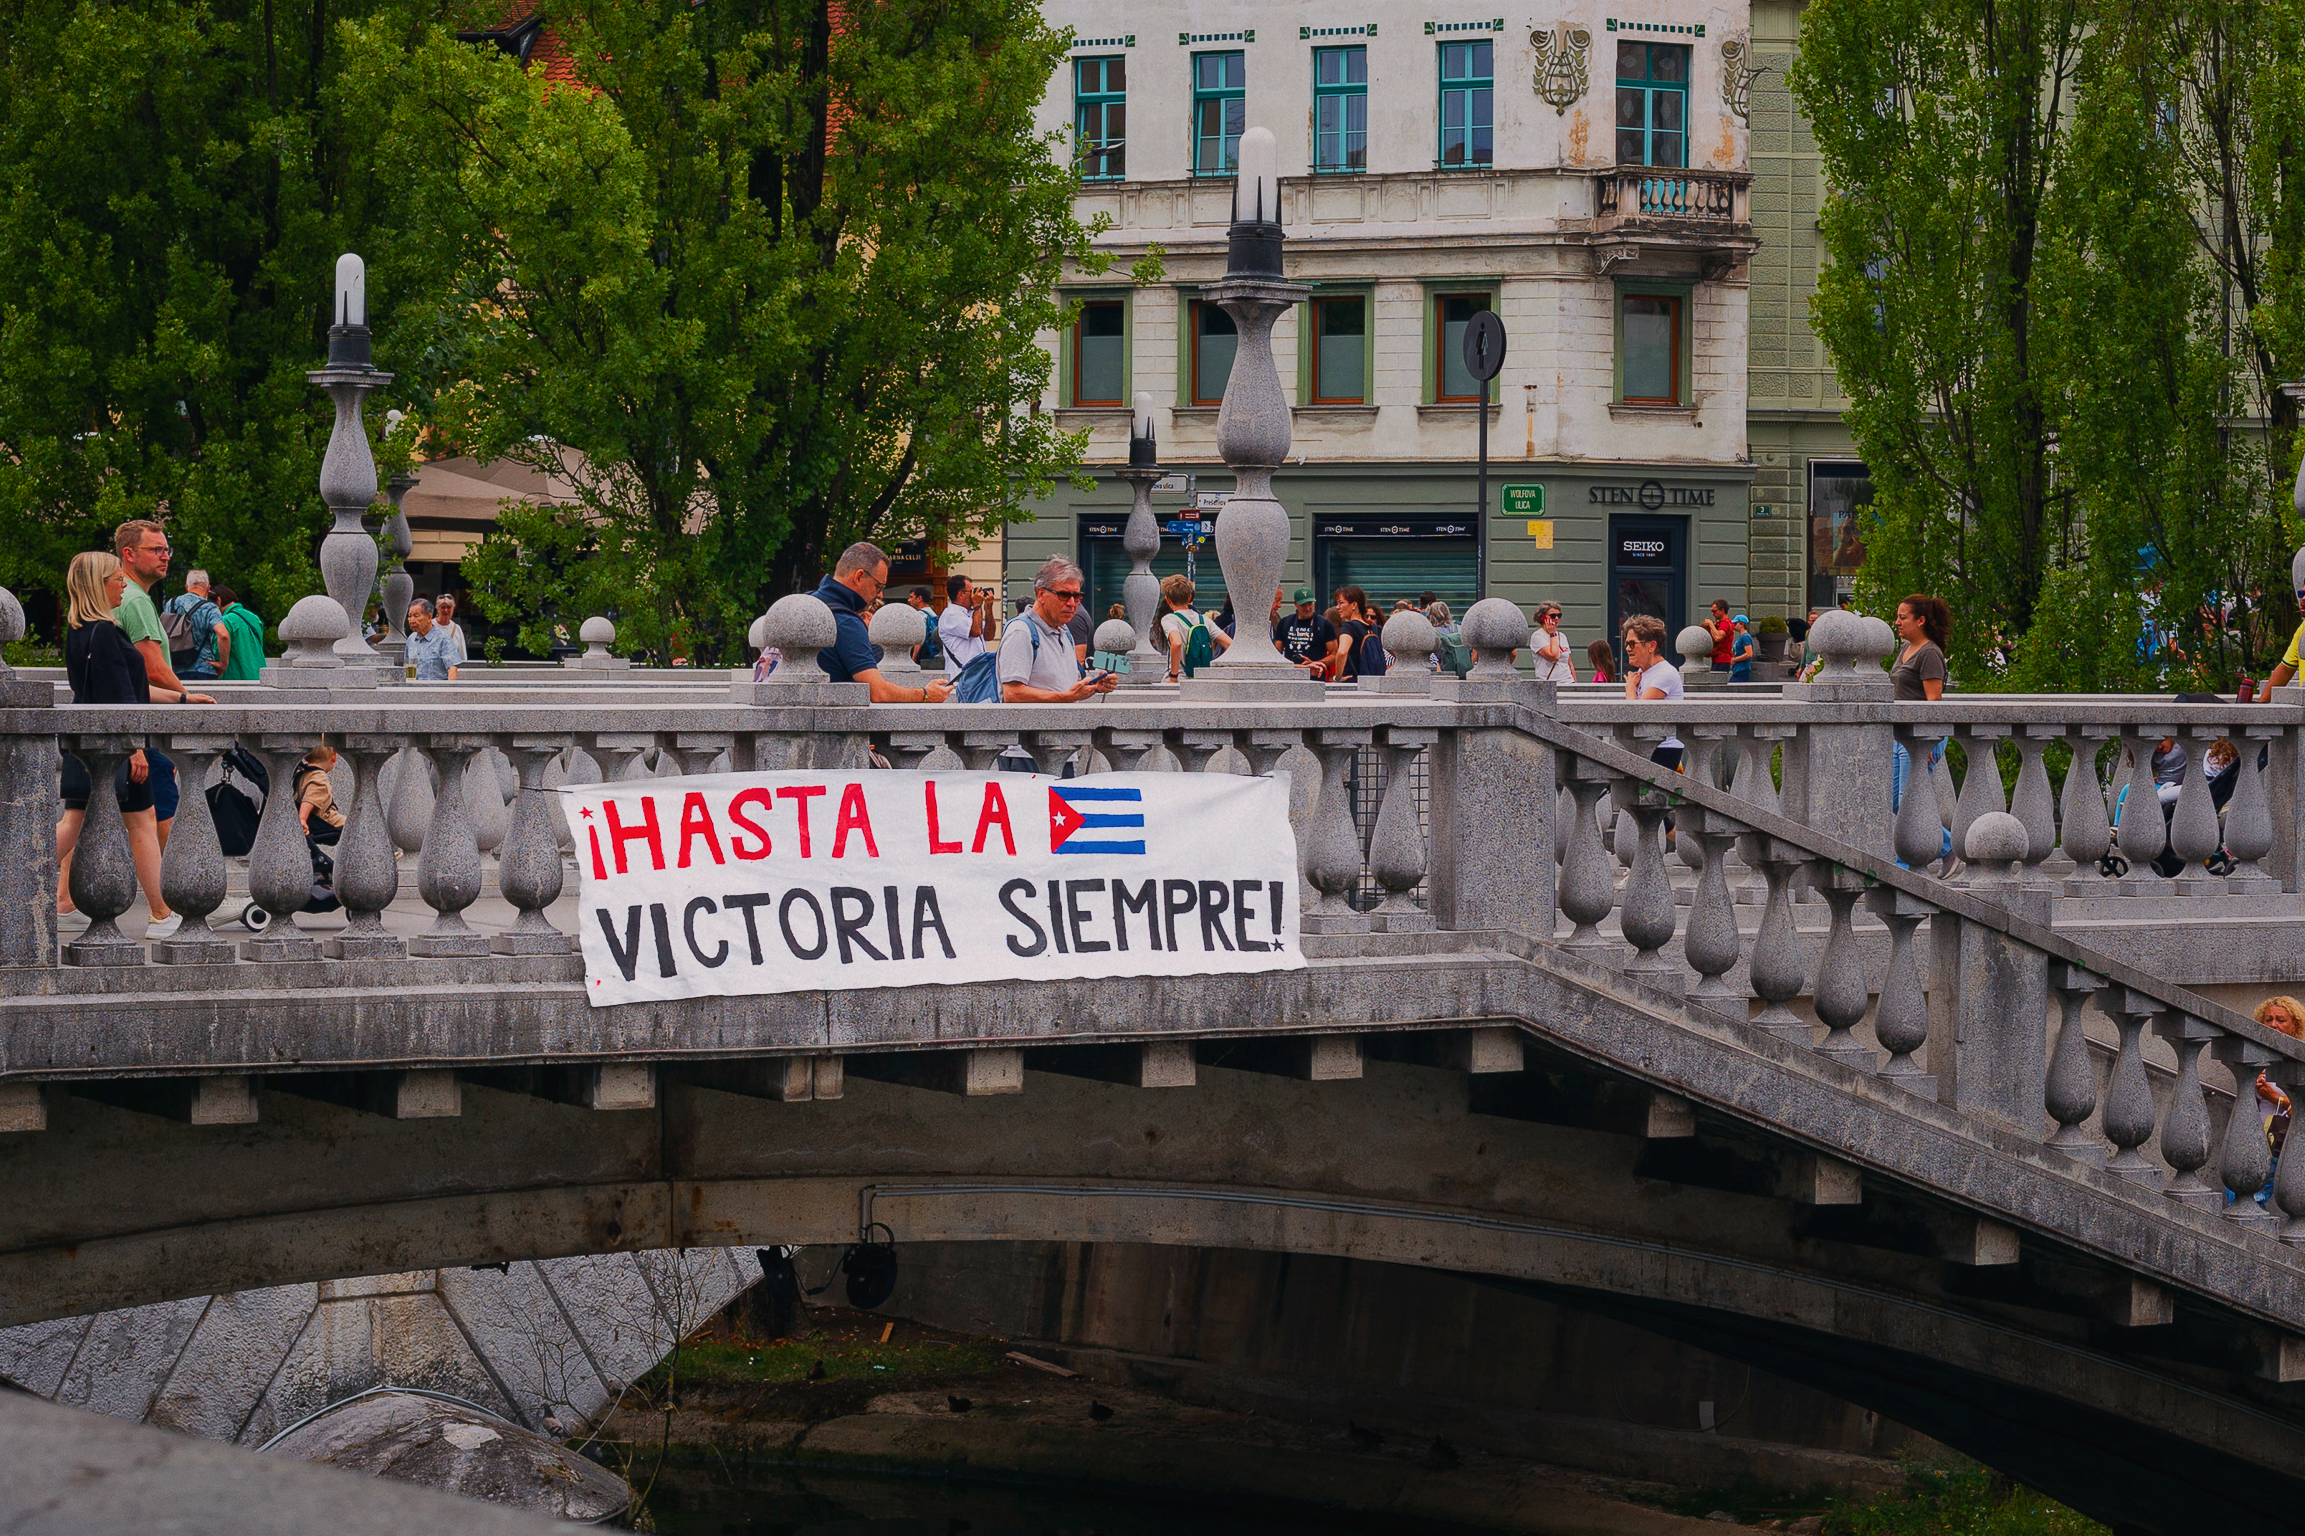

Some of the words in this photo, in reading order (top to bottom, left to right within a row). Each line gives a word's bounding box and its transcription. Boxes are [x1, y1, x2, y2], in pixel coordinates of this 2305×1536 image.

[1510, 489, 1536, 498] WOLFOVA
[1589, 486, 1634, 504] STEN
[1669, 488, 1715, 506] TIME
[1515, 501, 1531, 509] ULICA
[1623, 541, 1665, 552] SEIKO
[578, 782, 879, 881] ¡HASTA
[924, 780, 1017, 858] LA
[596, 885, 956, 982] VICTORIA
[998, 878, 1285, 960] SIEMPRE!
